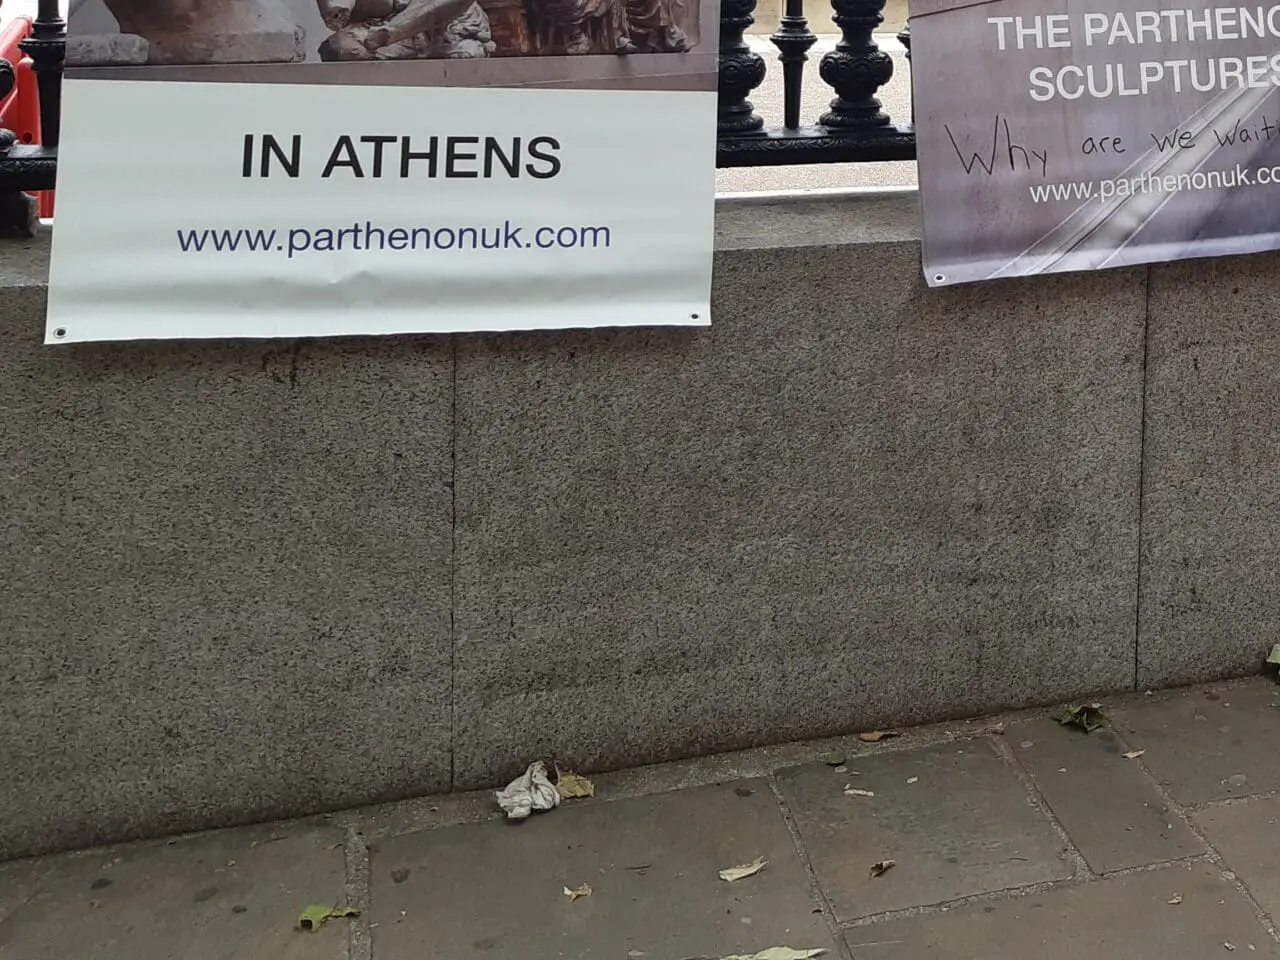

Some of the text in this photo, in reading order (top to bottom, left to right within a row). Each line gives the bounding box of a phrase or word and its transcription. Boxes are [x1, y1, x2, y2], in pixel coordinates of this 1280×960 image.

[987, 14, 1072, 51] THE
[242, 133, 562, 178] IN ATHENS
[944, 114, 1048, 177] Why
[1082, 132, 1125, 156] are
[177, 219, 611, 258] www.parthenonuk.com
